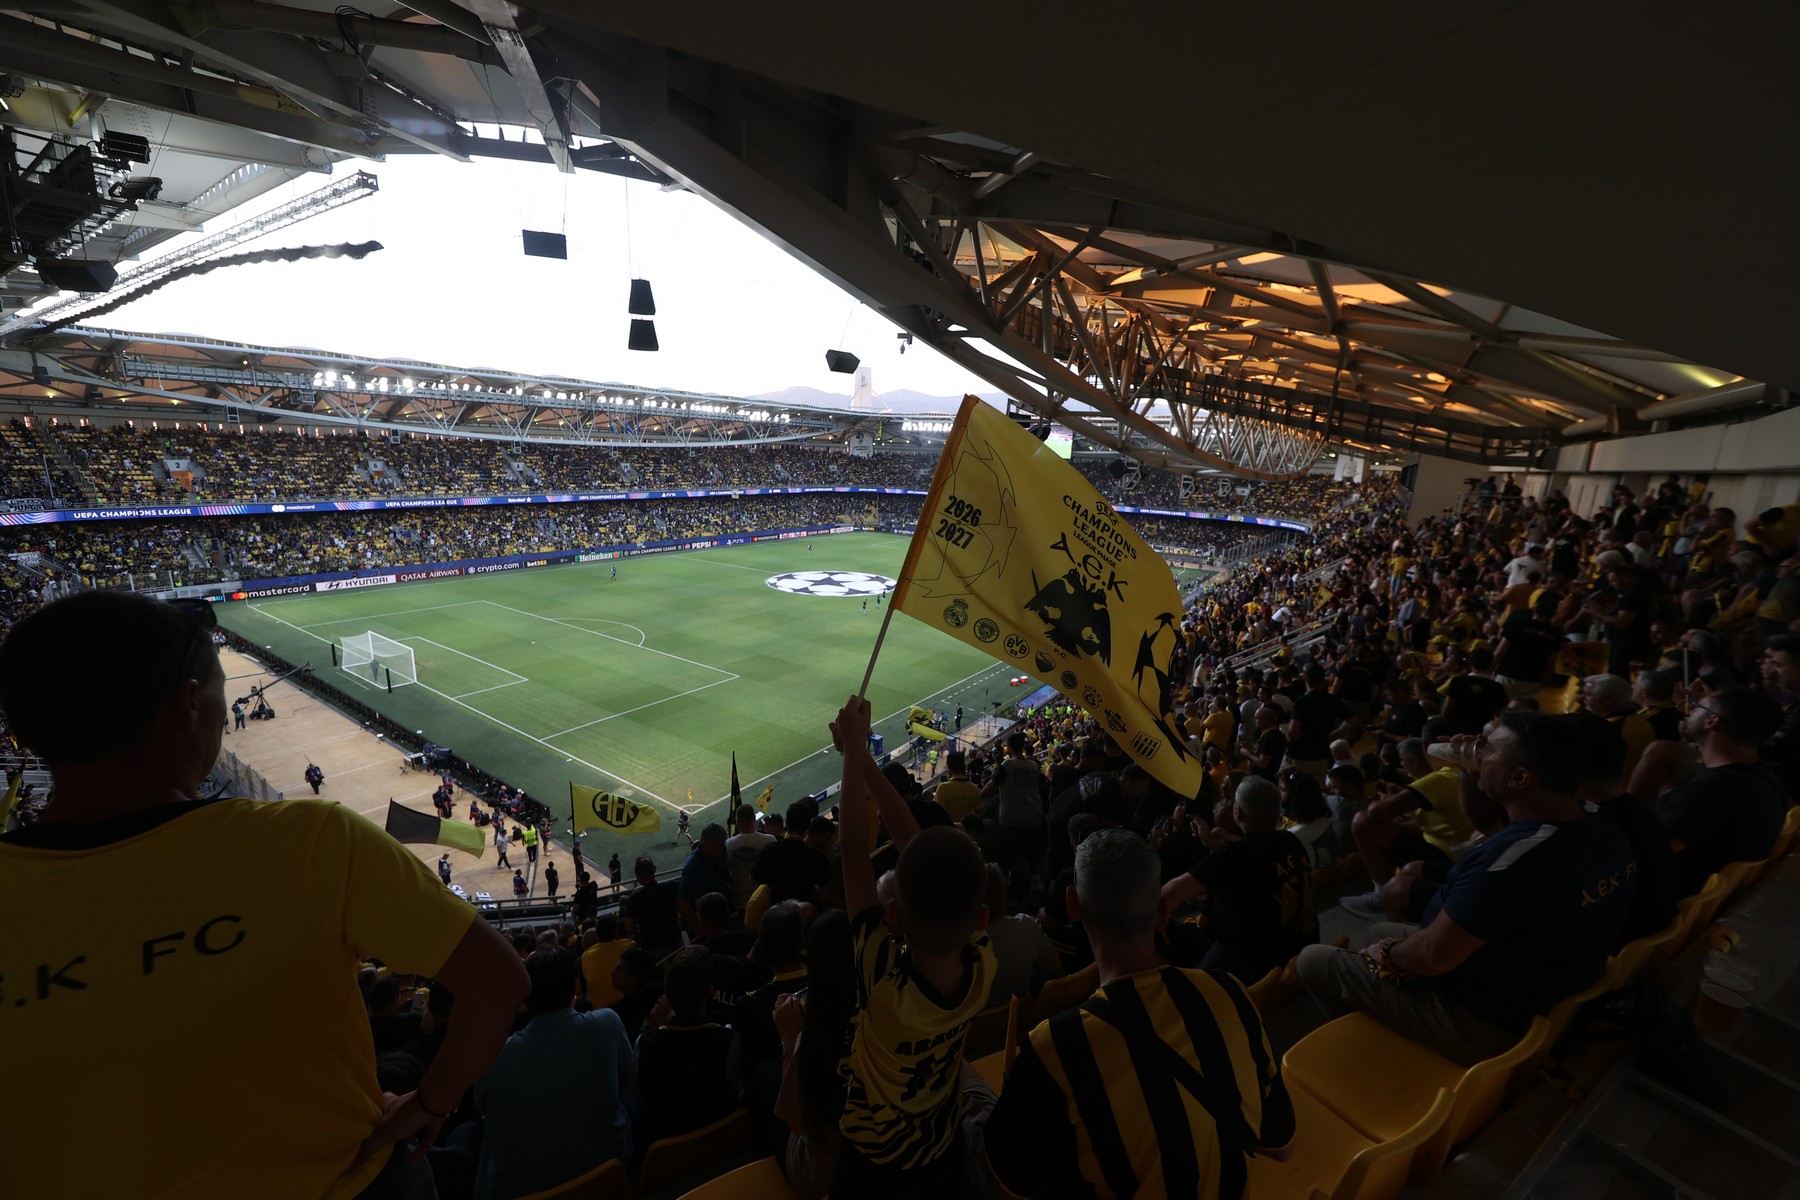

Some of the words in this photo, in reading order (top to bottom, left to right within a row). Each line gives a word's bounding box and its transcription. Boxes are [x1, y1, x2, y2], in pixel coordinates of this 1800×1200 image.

[100, 509, 157, 518] CHAMPIONS
[158, 508, 192, 517] LEAGUE
[943, 494, 982, 528] 2026
[1096, 501, 1119, 526] UEFA
[935, 518, 975, 551] 2027
[1062, 494, 1138, 560] CHAMPIONS
[1073, 517, 1124, 562] LEAGUE
[579, 551, 613, 562] Heineken
[1073, 531, 1098, 553] LEAGUE
[1097, 549, 1116, 568] PHASE
[401, 573, 427, 582] QATAR
[429, 568, 460, 579] AIRWAYS
[477, 562, 520, 574] crypto.com
[345, 577, 388, 588] HYUNDAI
[249, 585, 310, 598] mastercard
[1006, 637, 1028, 655] BVB
[1009, 648, 1018, 656] 09
[1137, 733, 1159, 748] LASK
[142, 915, 246, 976] FC
